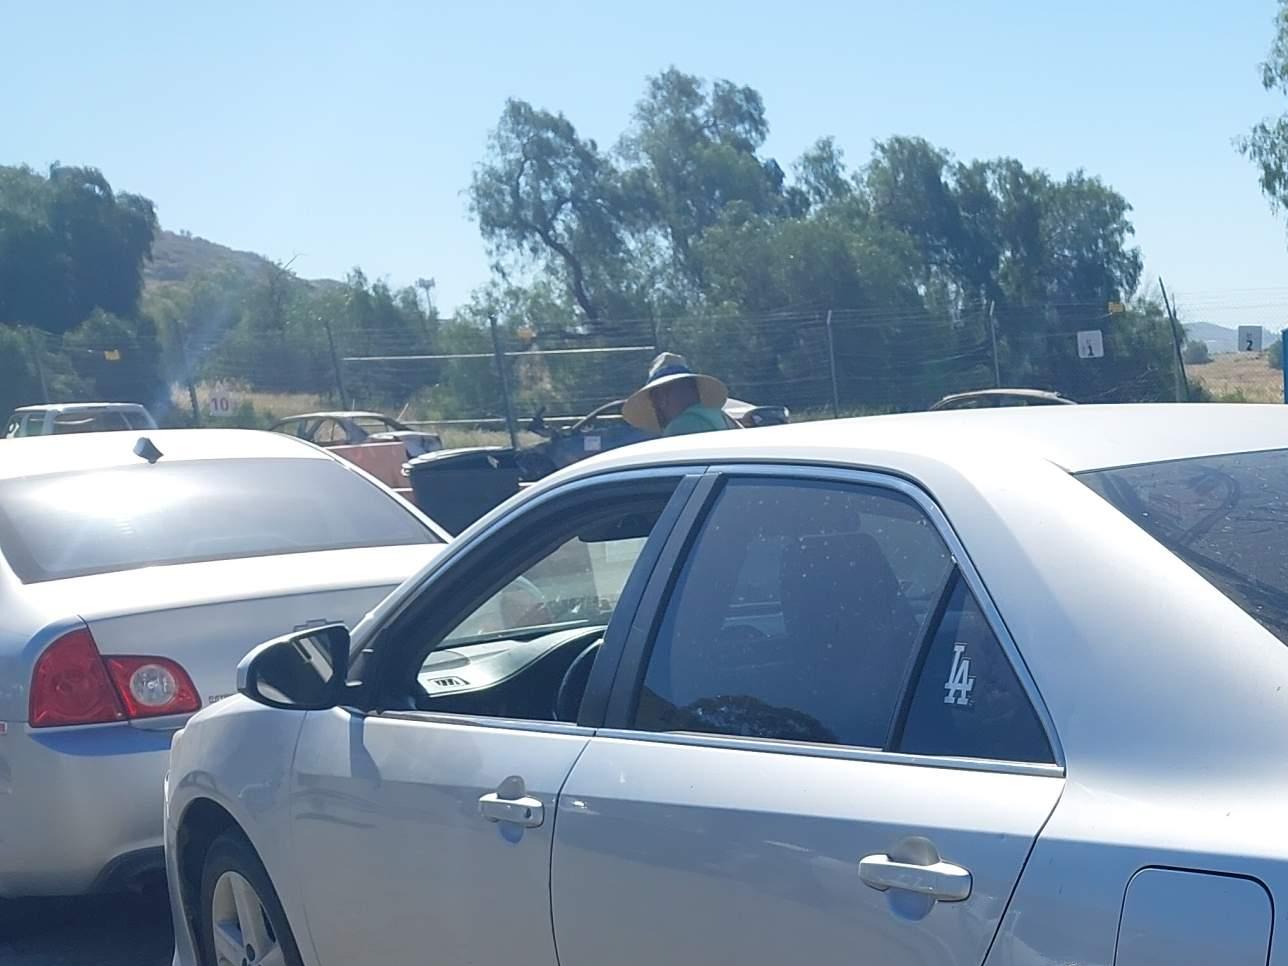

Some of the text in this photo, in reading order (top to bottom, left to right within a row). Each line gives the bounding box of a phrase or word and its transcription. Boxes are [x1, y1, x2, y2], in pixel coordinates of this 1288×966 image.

[1087, 346, 1094, 356] 1
[1246, 340, 1254, 351] 2
[210, 397, 229, 411] 10
[943, 642, 977, 705] LA
